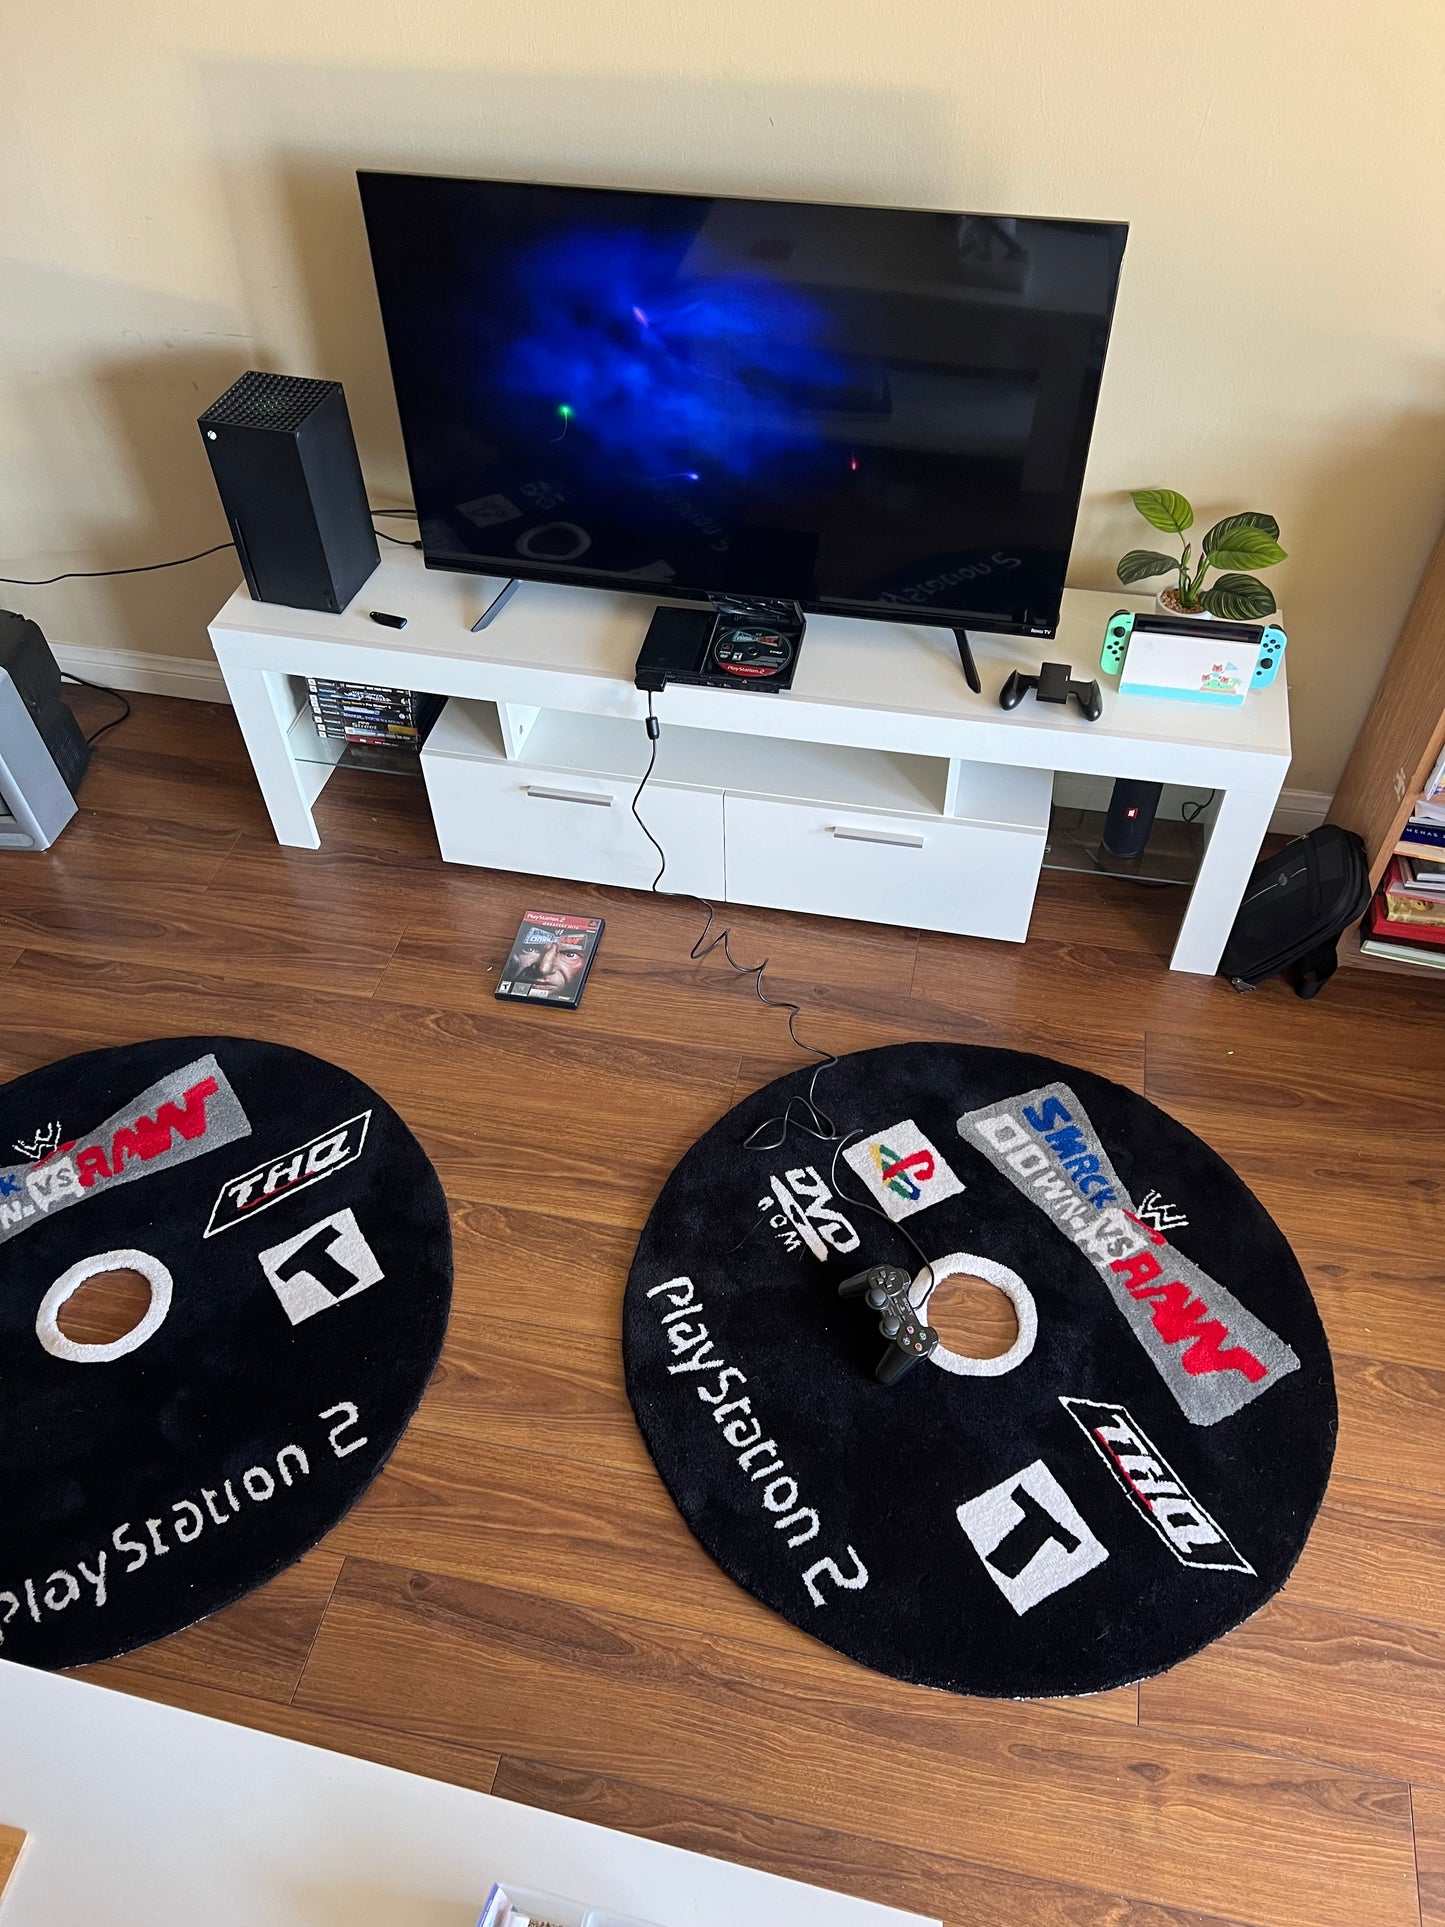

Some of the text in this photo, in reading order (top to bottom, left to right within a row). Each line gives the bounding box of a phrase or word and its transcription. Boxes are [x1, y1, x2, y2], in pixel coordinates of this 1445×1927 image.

[32, 1168, 71, 1196] VS
[228, 1130, 351, 1208] THQ
[274, 1224, 360, 1300] T
[1095, 1217, 1133, 1257] VS
[1110, 1251, 1269, 1383] RAW
[318, 1401, 368, 1458] 2
[1096, 1414, 1223, 1554] THQ
[985, 1483, 1082, 1580] T
[801, 1545, 869, 1608] 2
